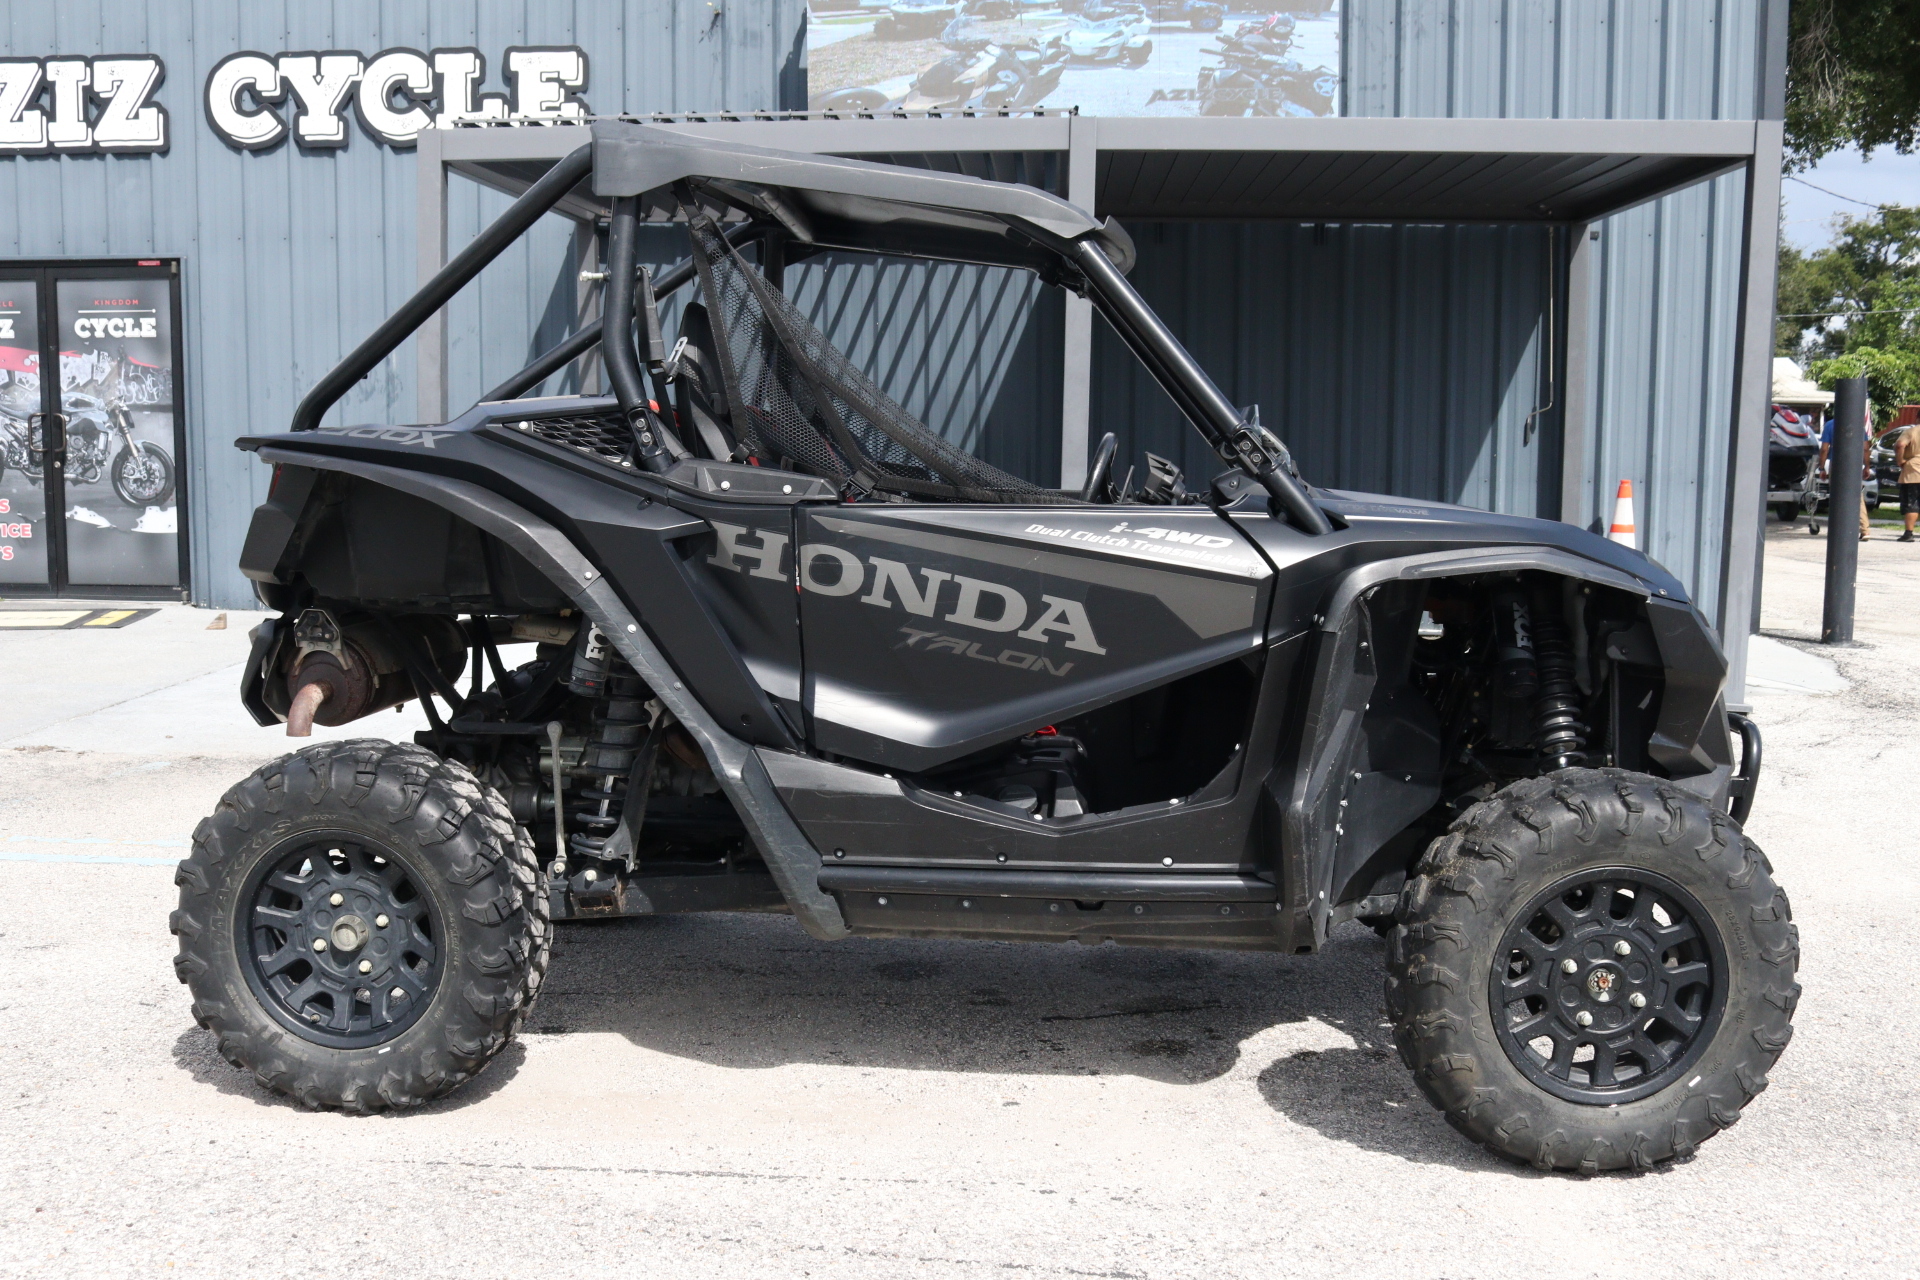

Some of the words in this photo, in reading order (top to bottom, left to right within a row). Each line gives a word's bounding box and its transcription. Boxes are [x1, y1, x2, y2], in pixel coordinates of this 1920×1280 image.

[206, 47, 588, 148] CYCLE
[74, 317, 157, 338] CYCLE
[1025, 524, 1071, 537] Dual
[1071, 531, 1129, 547] Clutch
[1131, 539, 1253, 569] Transmission
[1109, 522, 1234, 549] i-4WD
[706, 519, 1107, 655] HONDA
[585, 622, 611, 661] FO
[1513, 602, 1533, 649] FOX
[899, 627, 1075, 677] TALON
